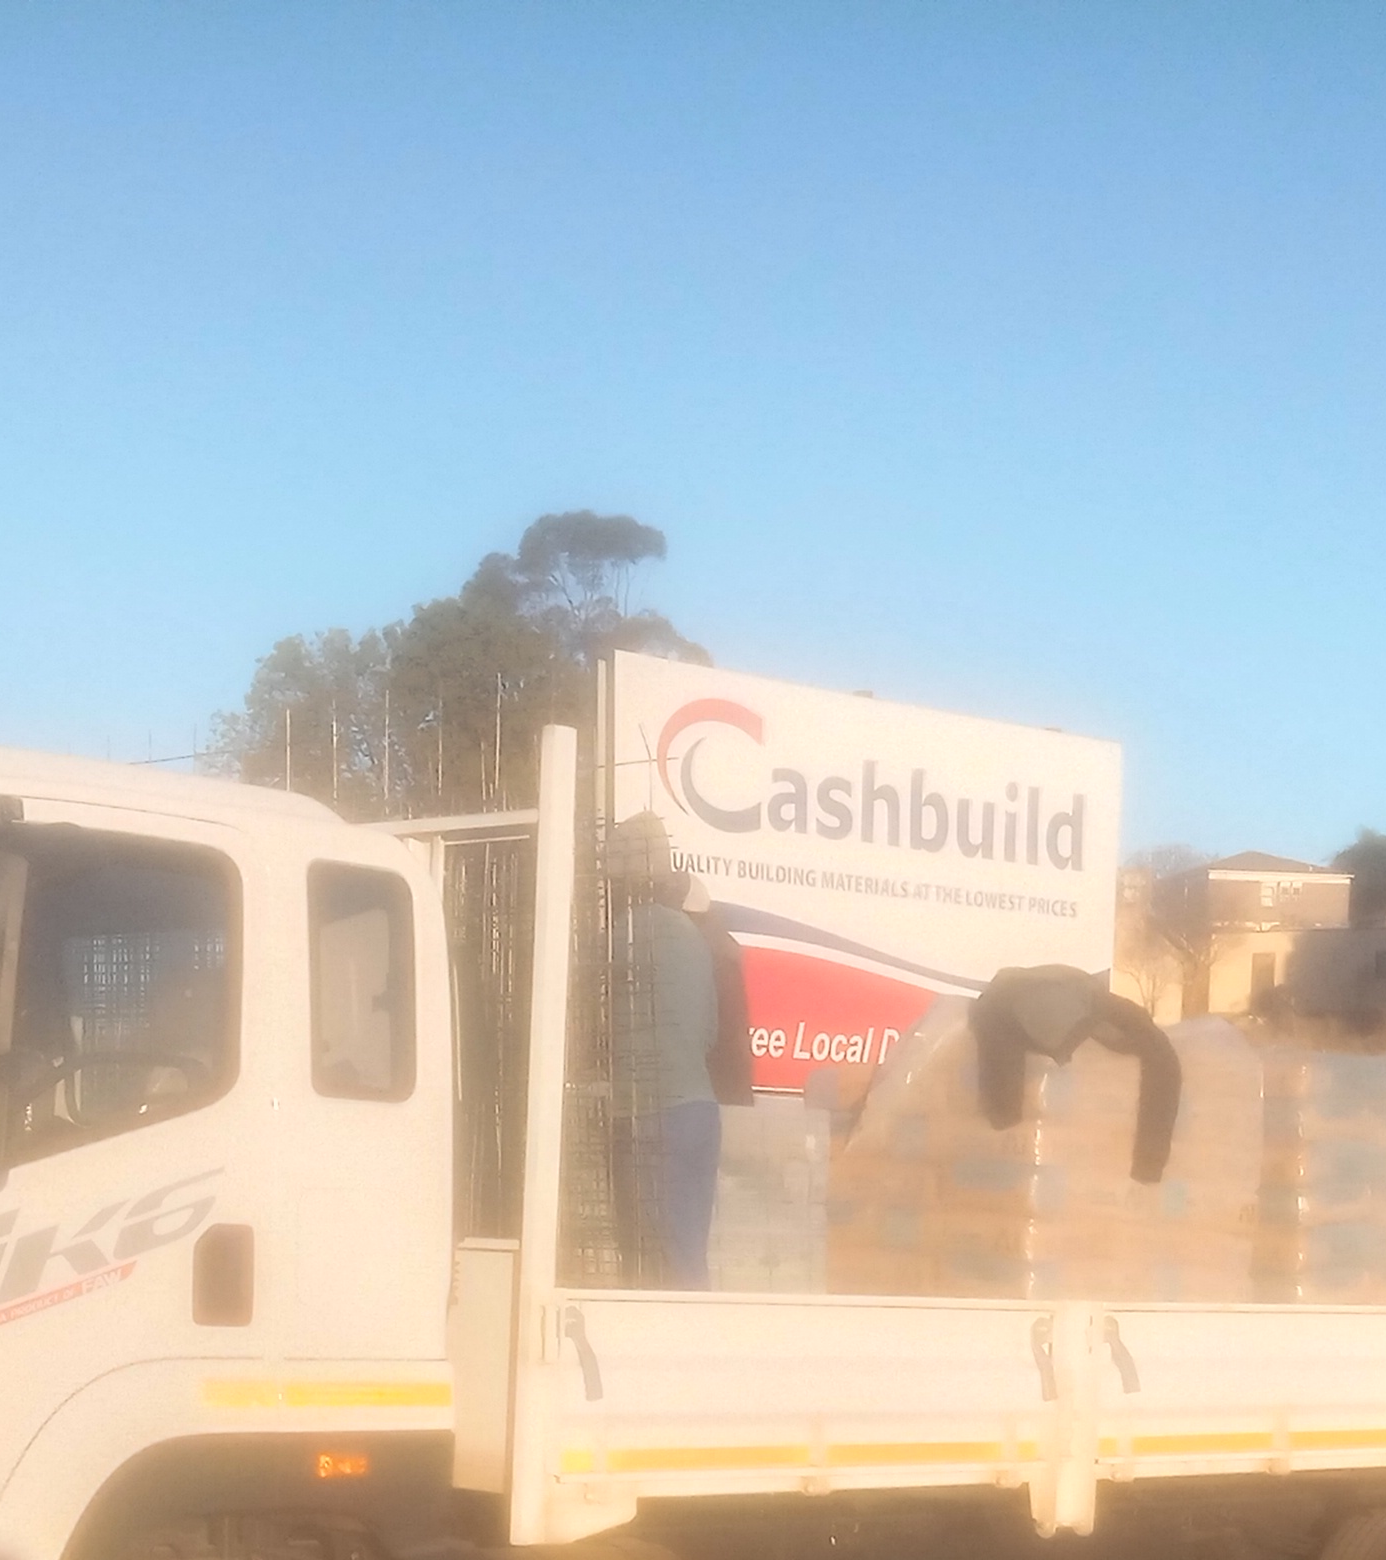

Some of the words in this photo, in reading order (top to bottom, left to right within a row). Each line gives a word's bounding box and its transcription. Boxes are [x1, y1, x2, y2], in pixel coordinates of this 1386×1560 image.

[657, 698, 1085, 871] Cashbuild
[671, 851, 733, 877] UALITY
[737, 860, 817, 888] BUILDING
[821, 871, 909, 899] MATERIALS
[913, 883, 931, 901] AT
[934, 884, 962, 906] THE
[965, 889, 1025, 912] LOWEST
[1028, 896, 1079, 918] PRICES
[749, 1027, 787, 1058] ee
[793, 1022, 875, 1064] Local
[81, 1268, 122, 1295] FAW
